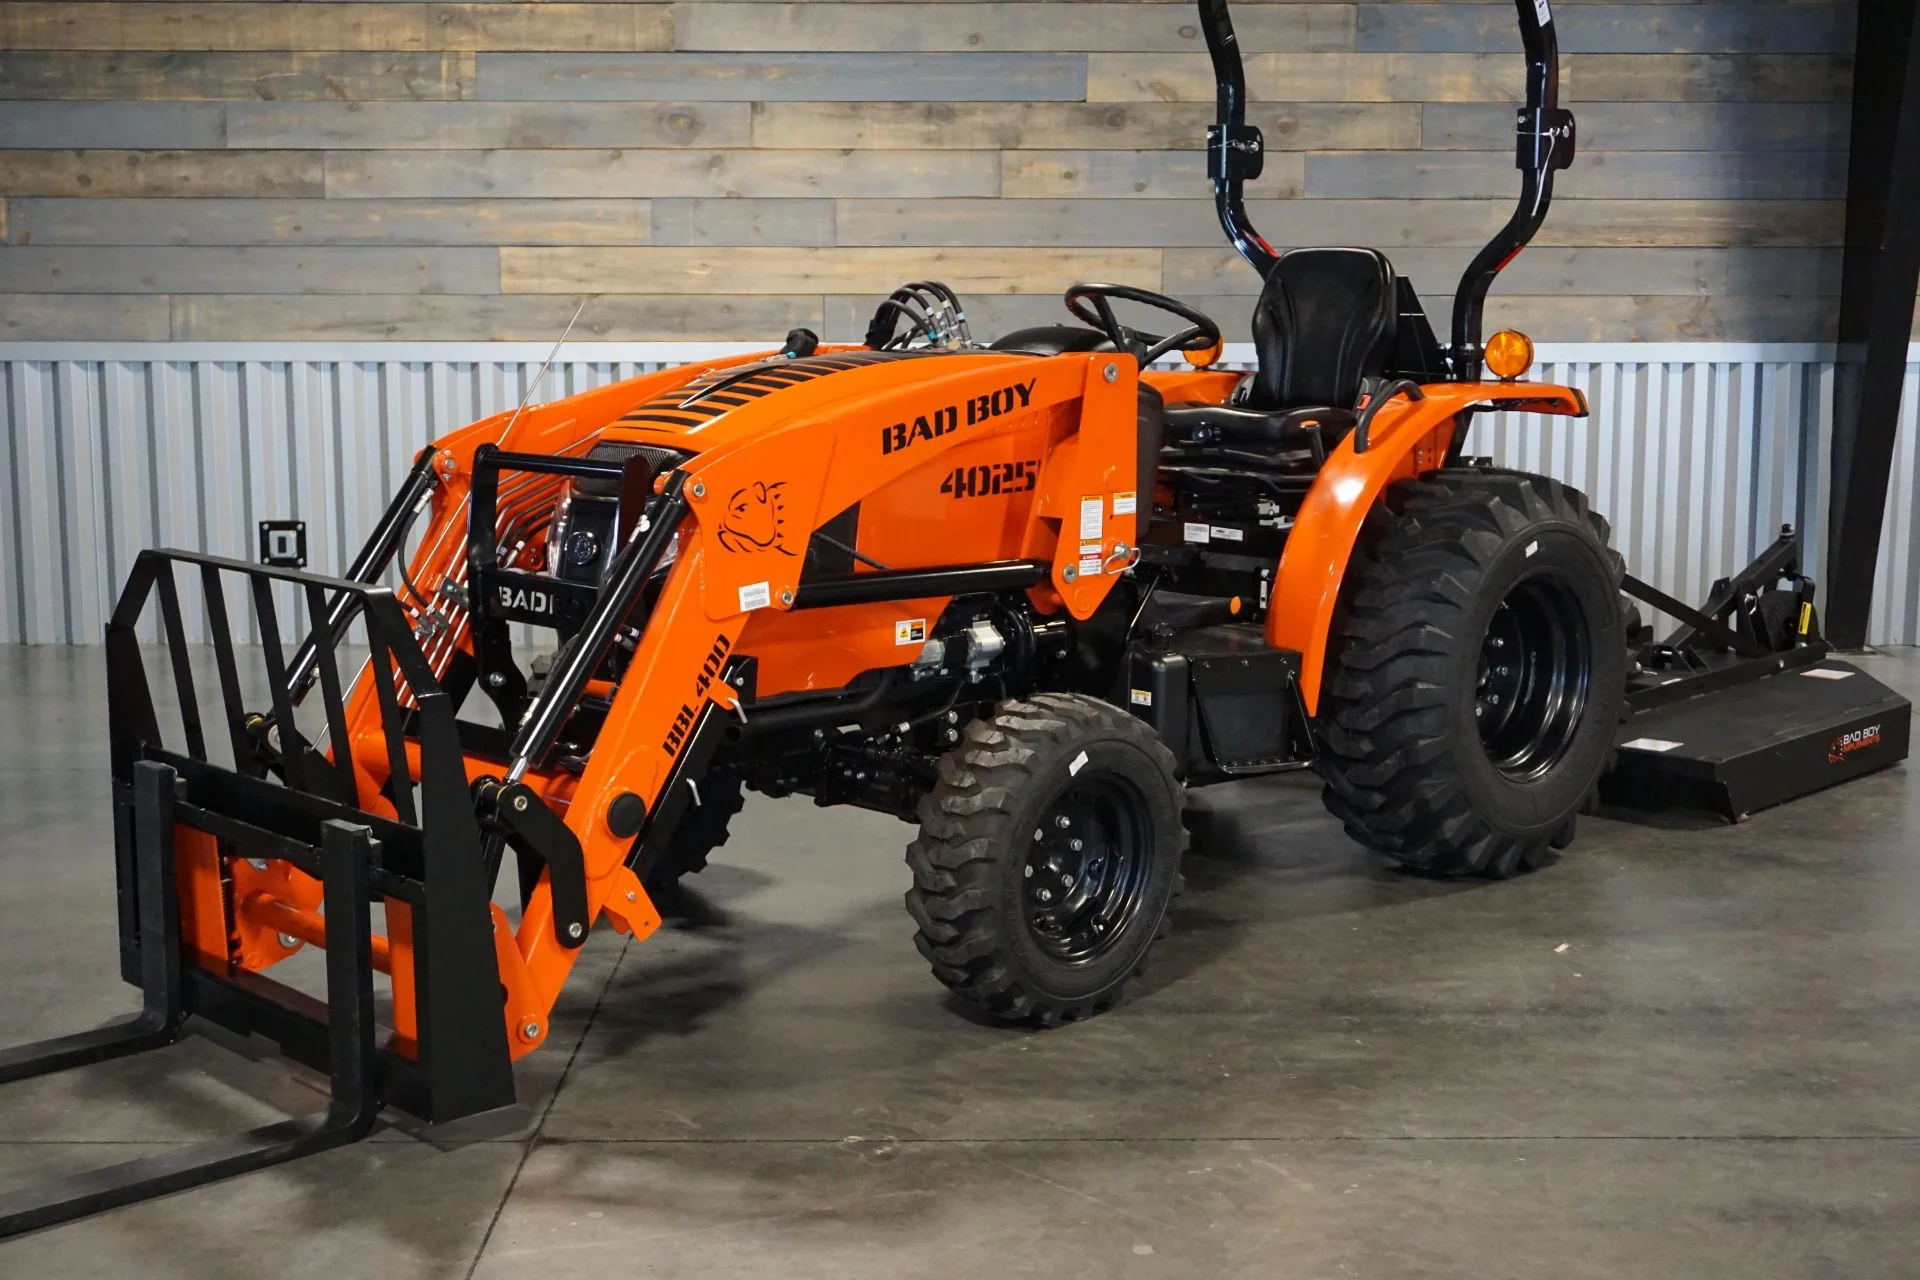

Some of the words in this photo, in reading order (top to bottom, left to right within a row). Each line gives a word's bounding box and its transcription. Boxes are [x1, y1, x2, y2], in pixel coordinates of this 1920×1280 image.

[882, 405, 957, 455] BAD
[967, 377, 1036, 426] BOY
[940, 460, 1041, 499] 4025
[662, 703, 699, 757] BBL
[696, 634, 730, 698] 400
[1843, 731, 1861, 745] BAD
[1863, 724, 1880, 739] BOY
